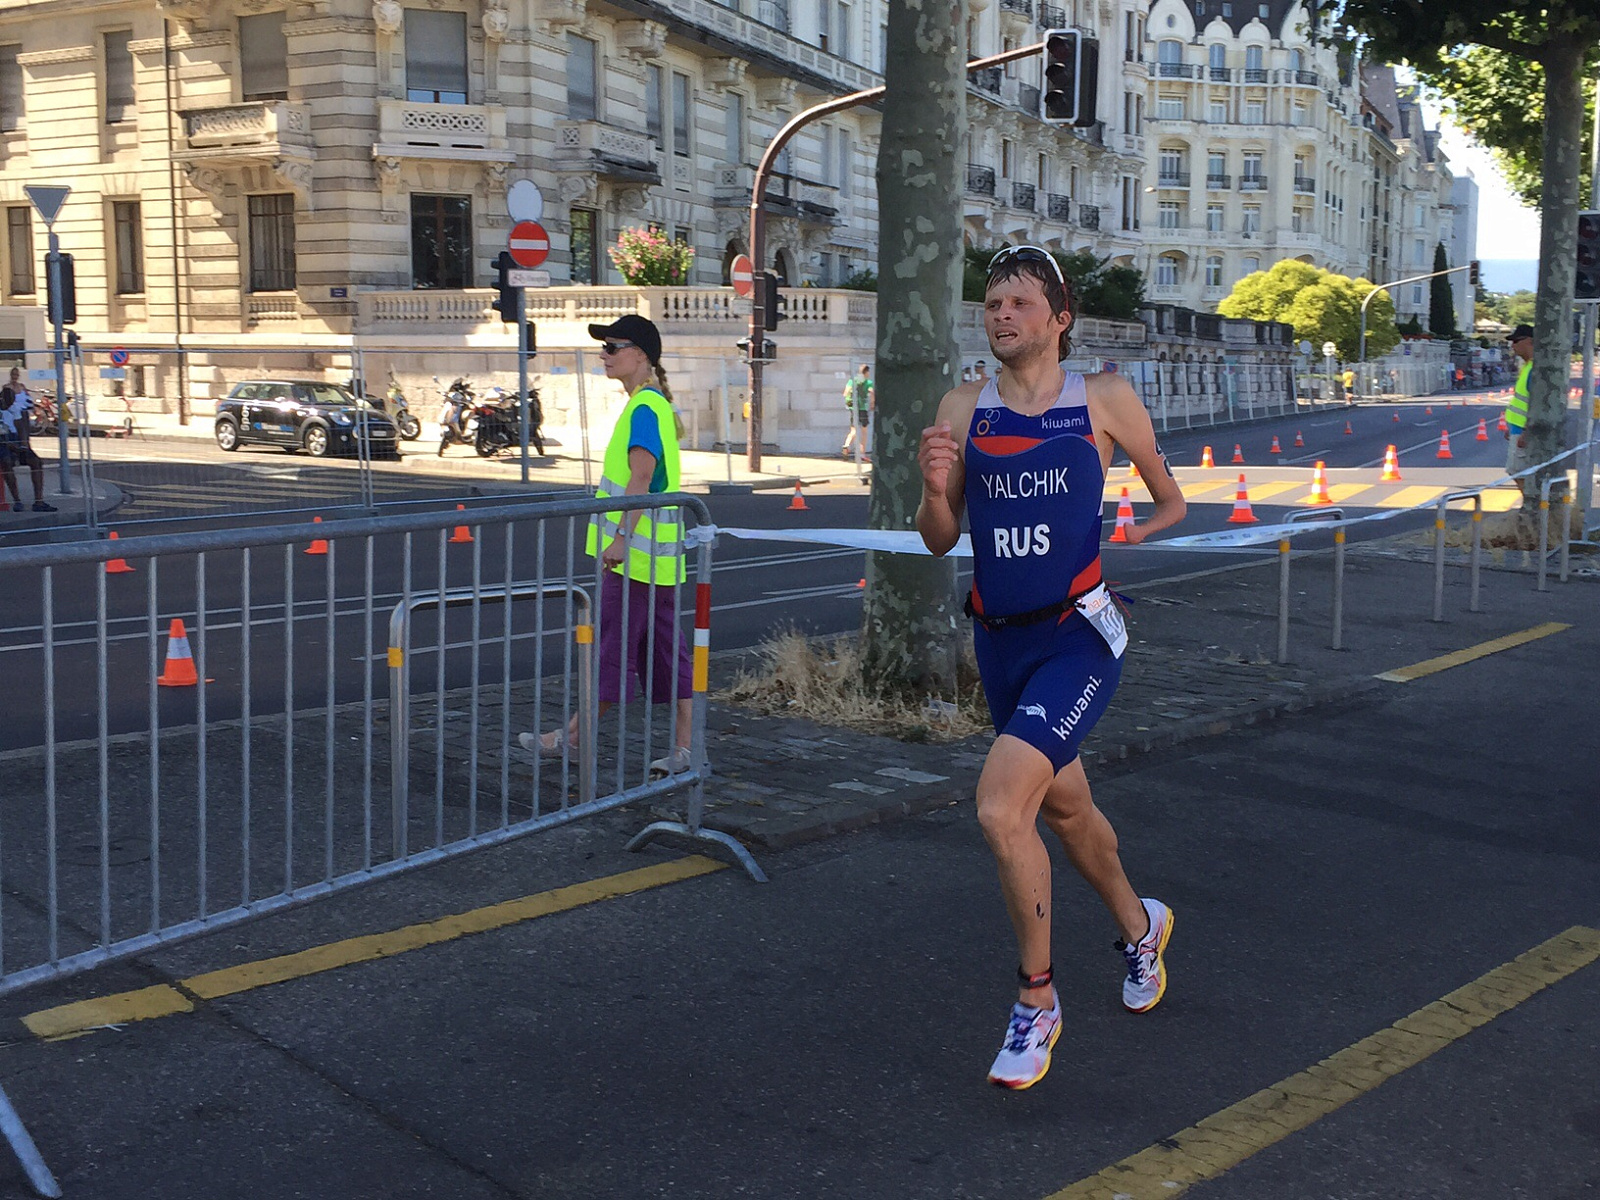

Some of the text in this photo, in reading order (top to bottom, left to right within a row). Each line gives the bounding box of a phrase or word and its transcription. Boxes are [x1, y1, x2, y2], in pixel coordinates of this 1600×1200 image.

[1041, 415, 1085, 430] kiwami
[981, 467, 1069, 499] YALCHIK
[993, 523, 1050, 559] RUS
